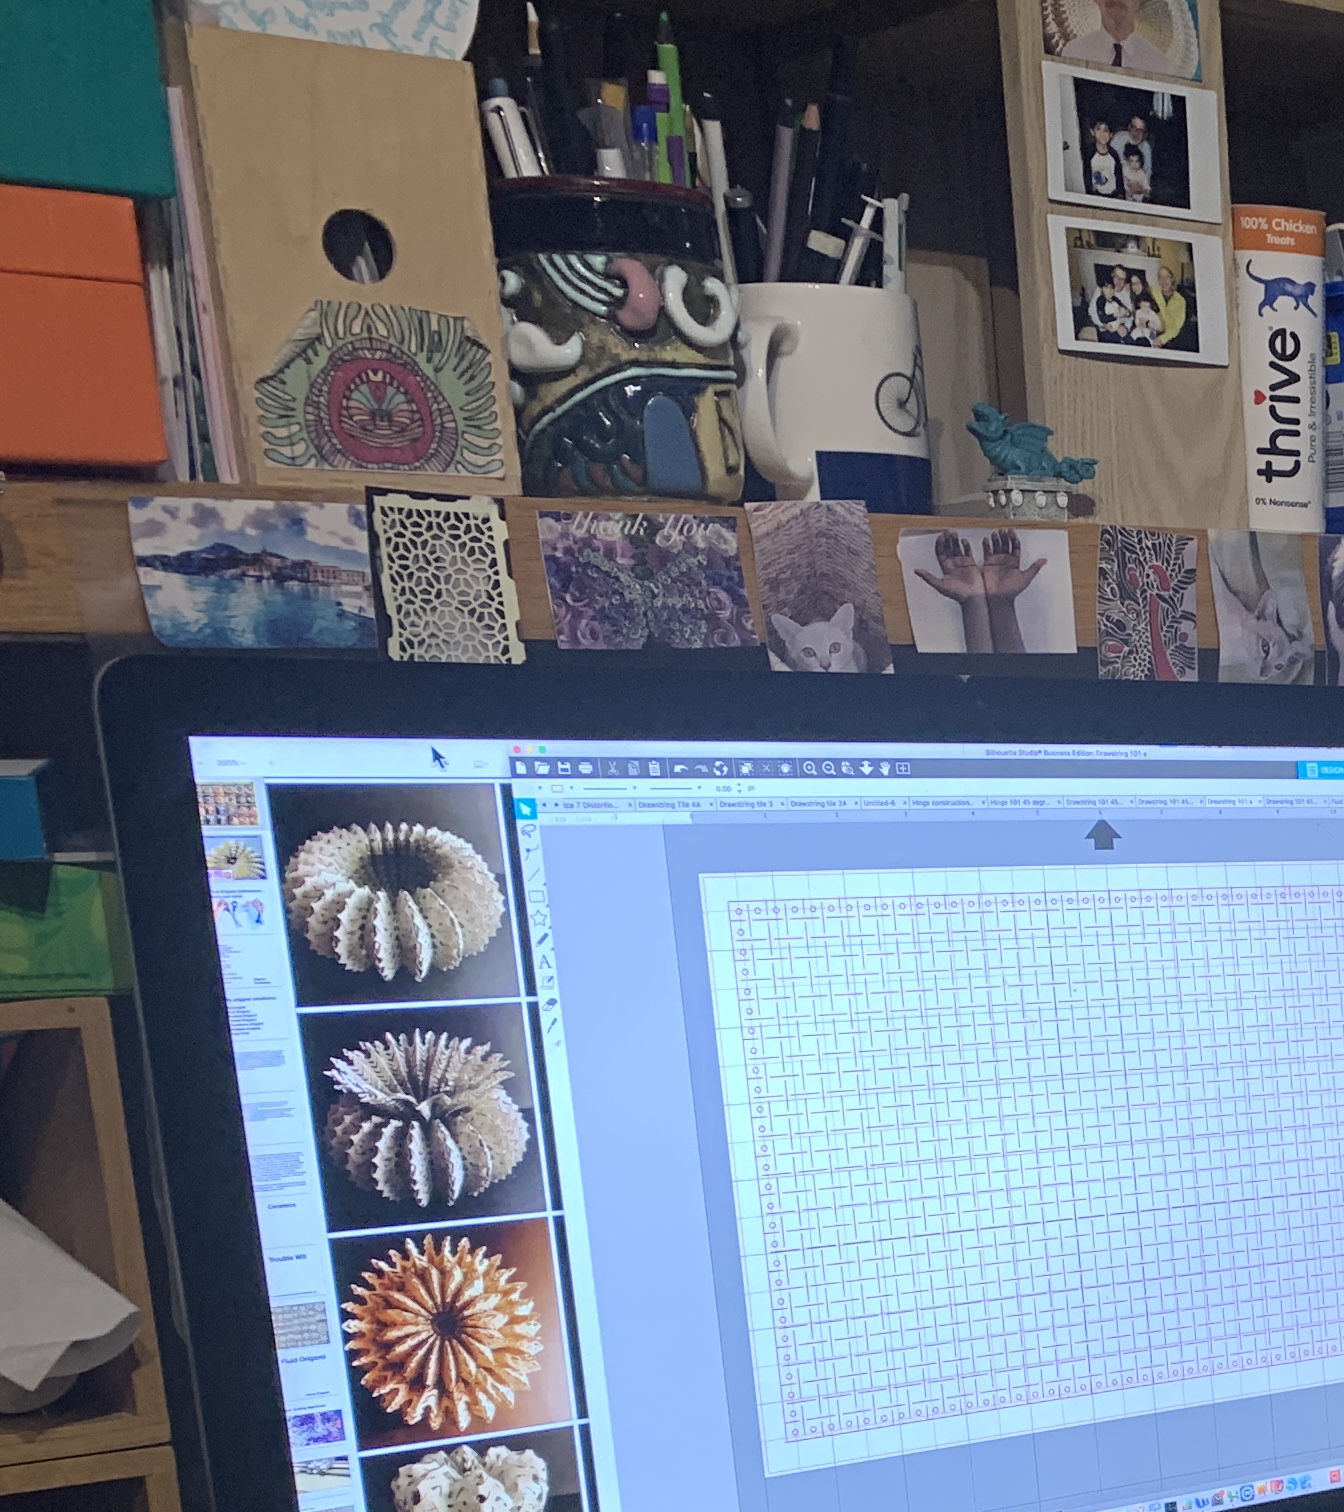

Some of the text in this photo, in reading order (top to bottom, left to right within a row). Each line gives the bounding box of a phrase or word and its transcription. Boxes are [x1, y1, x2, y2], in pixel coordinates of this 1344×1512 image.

[1240, 216, 1318, 235] 100% Chicken
[1266, 233, 1295, 246] Treats
[1308, 352, 1317, 464] Pure & Irresistible
[1255, 497, 1268, 506] 0%
[638, 801, 675, 810] Drawstring
[719, 800, 755, 809] Drawstring
[790, 800, 825, 809] Drawstring
[1066, 799, 1097, 807] Drawstring
[1138, 798, 1168, 807] Drawstring
[1207, 798, 1237, 807] Drawstring
[1266, 798, 1294, 807] Drawstring
[281, 1354, 327, 1365] Fluid Origami
